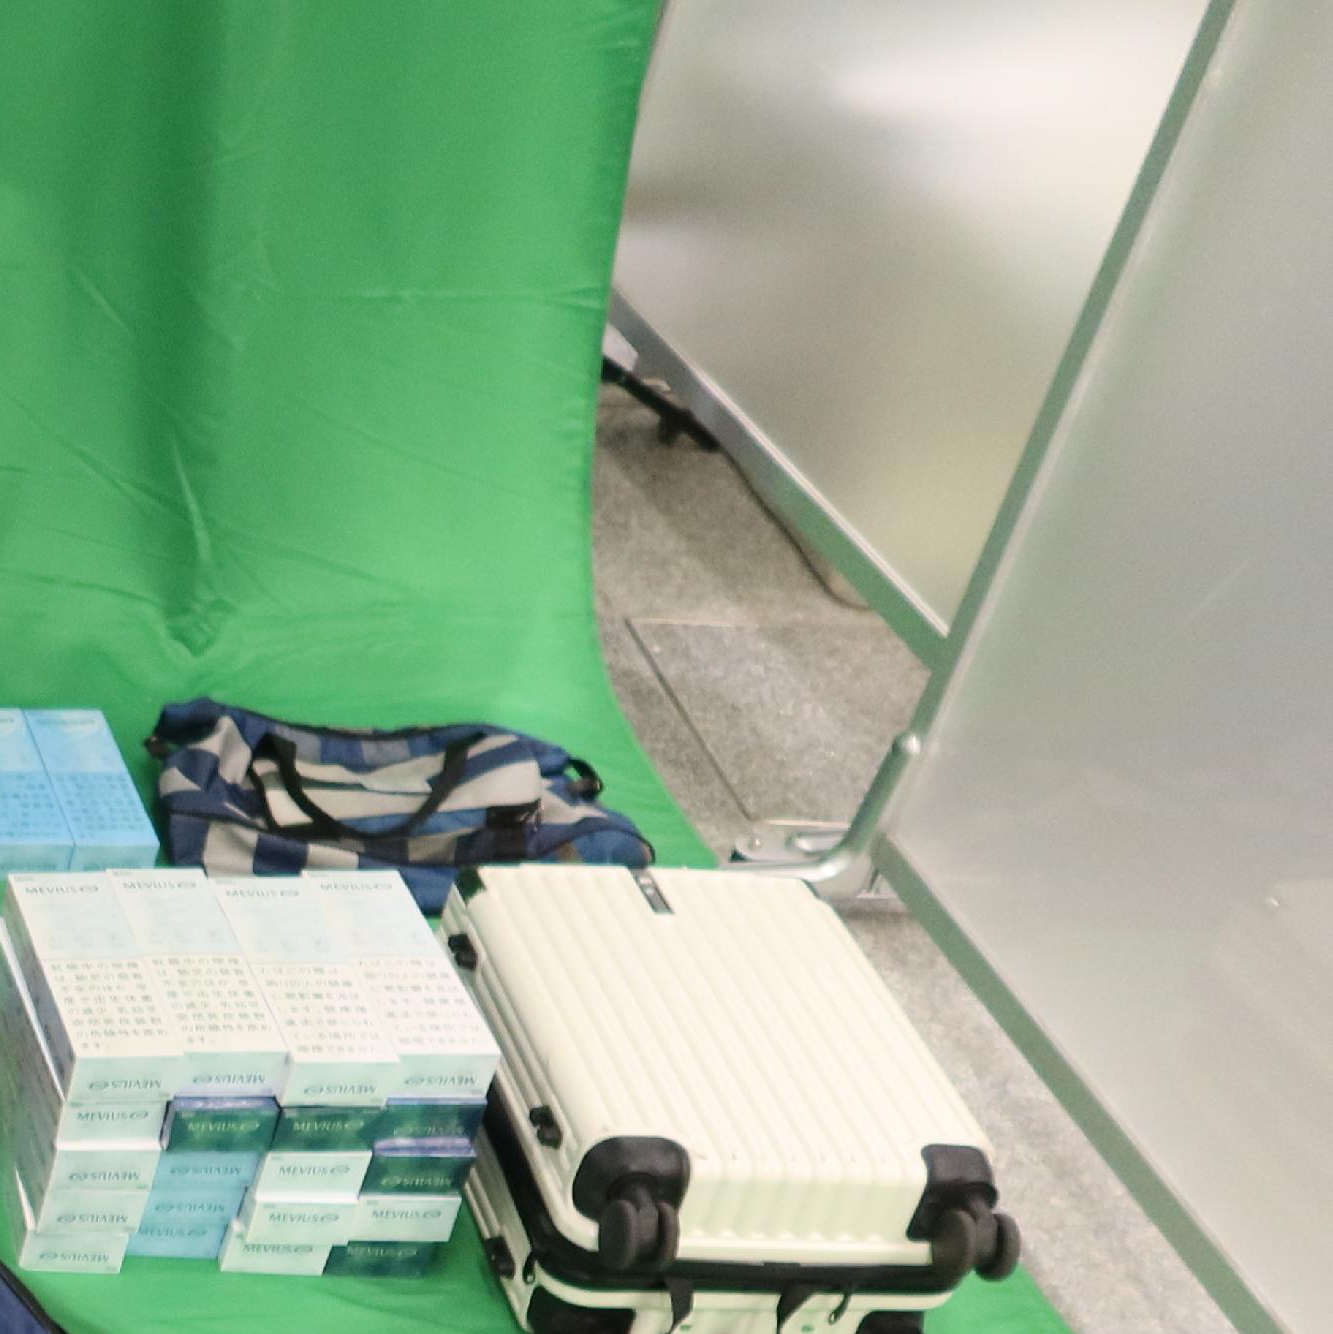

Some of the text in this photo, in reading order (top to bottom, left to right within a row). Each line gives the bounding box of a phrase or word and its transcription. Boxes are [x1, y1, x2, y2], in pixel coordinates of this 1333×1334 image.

[25, 886, 77, 894] MEVIUS
[217, 1075, 265, 1084] MEVIUS
[112, 1080, 161, 1089] MEVIUS
[325, 1085, 375, 1094] MEVIUS
[77, 1112, 128, 1120] MEVIUS
[280, 1166, 328, 1175] MEVIUS
[269, 1214, 317, 1222] MEVIUS
[372, 1210, 420, 1219] MEVIUS
